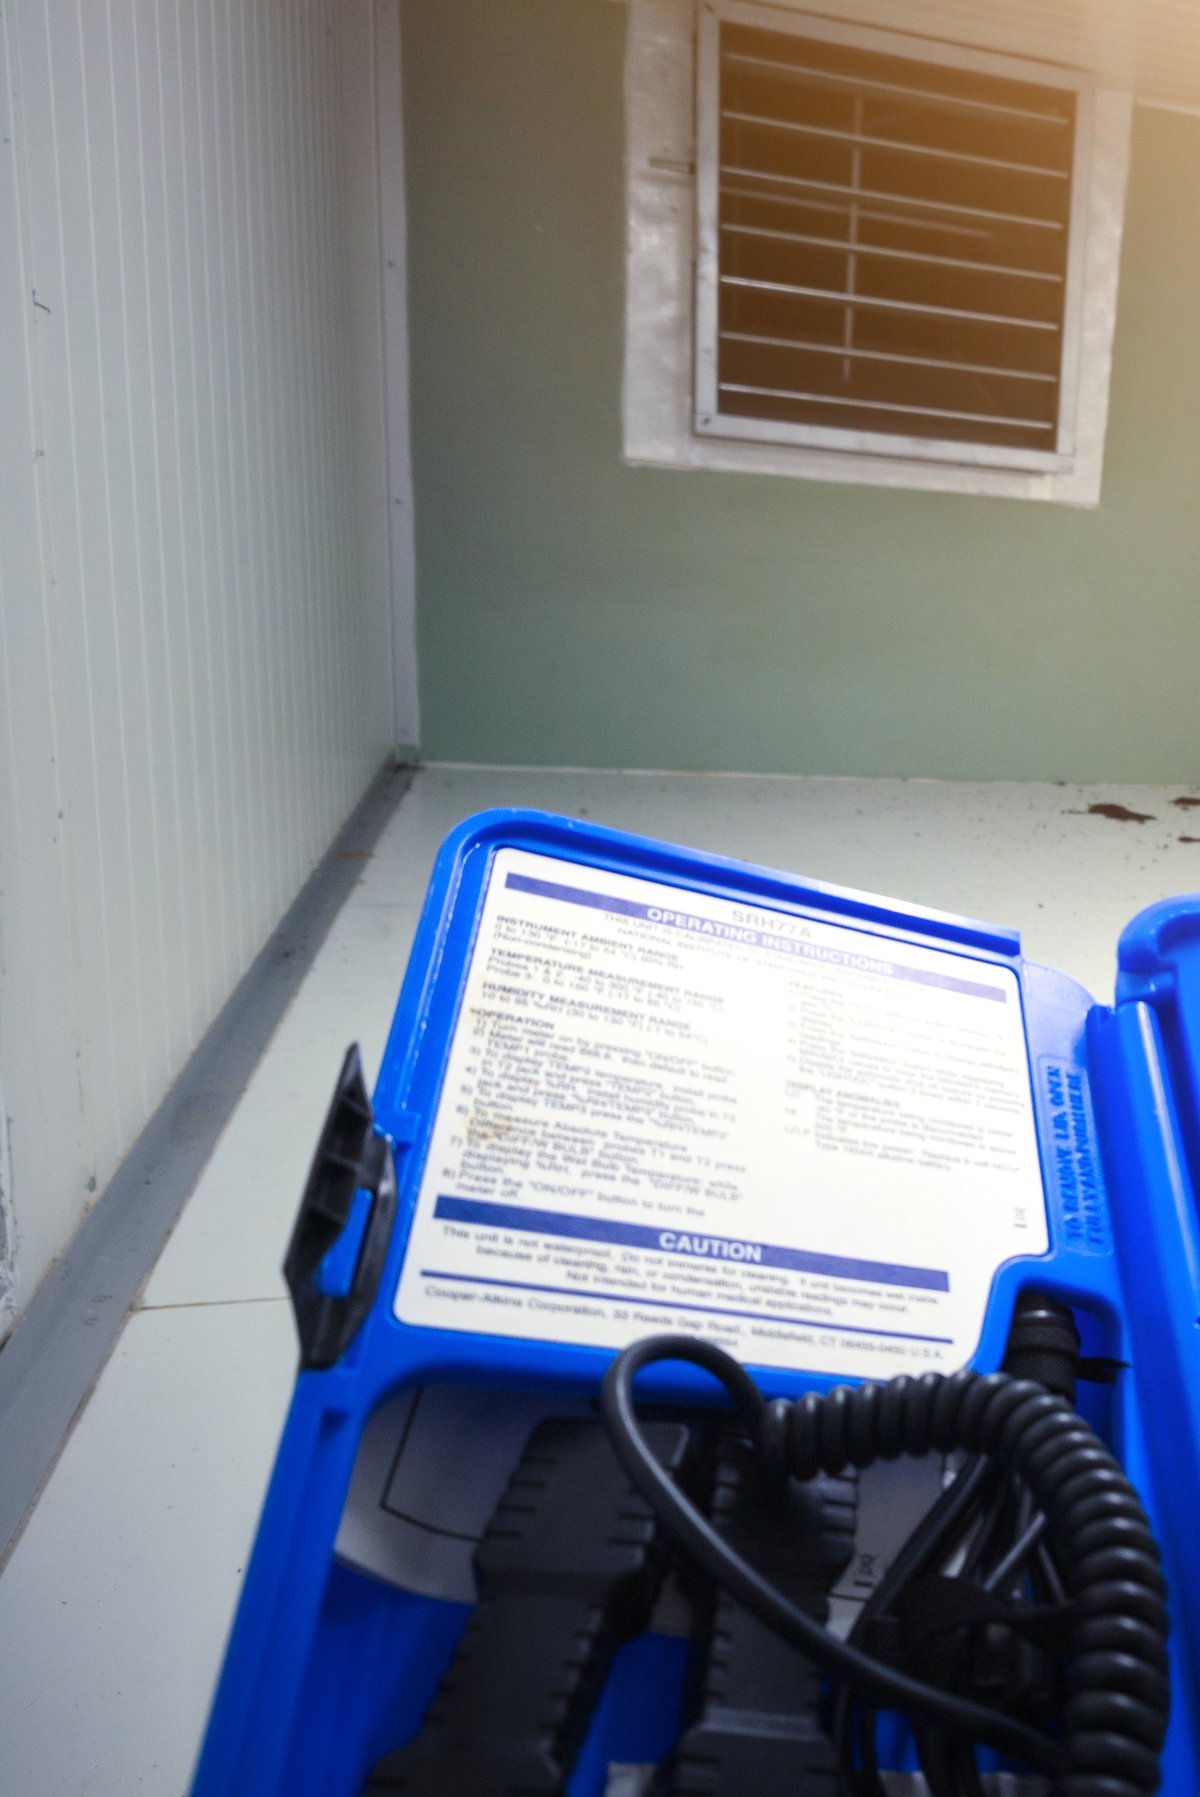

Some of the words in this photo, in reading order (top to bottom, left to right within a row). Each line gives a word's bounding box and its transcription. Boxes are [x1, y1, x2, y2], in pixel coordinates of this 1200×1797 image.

[495, 913, 577, 939] INSTRUMENT
[580, 932, 634, 952] AMBIENT
[636, 945, 679, 962] RANGE
[644, 905, 758, 945] OPERATING
[760, 933, 896, 977] INSTRUCTIONS
[730, 909, 813, 940] SRH77A
[489, 946, 584, 974] TEMPERATURE
[587, 967, 681, 995] MEASUREMENT
[682, 987, 725, 1004] RANGE
[481, 980, 545, 1001] HUMIDITY
[548, 993, 646, 1021] MEASUREMENT
[647, 1014, 691, 1031] RANGE
[657, 1230, 764, 1263] CAUTION
